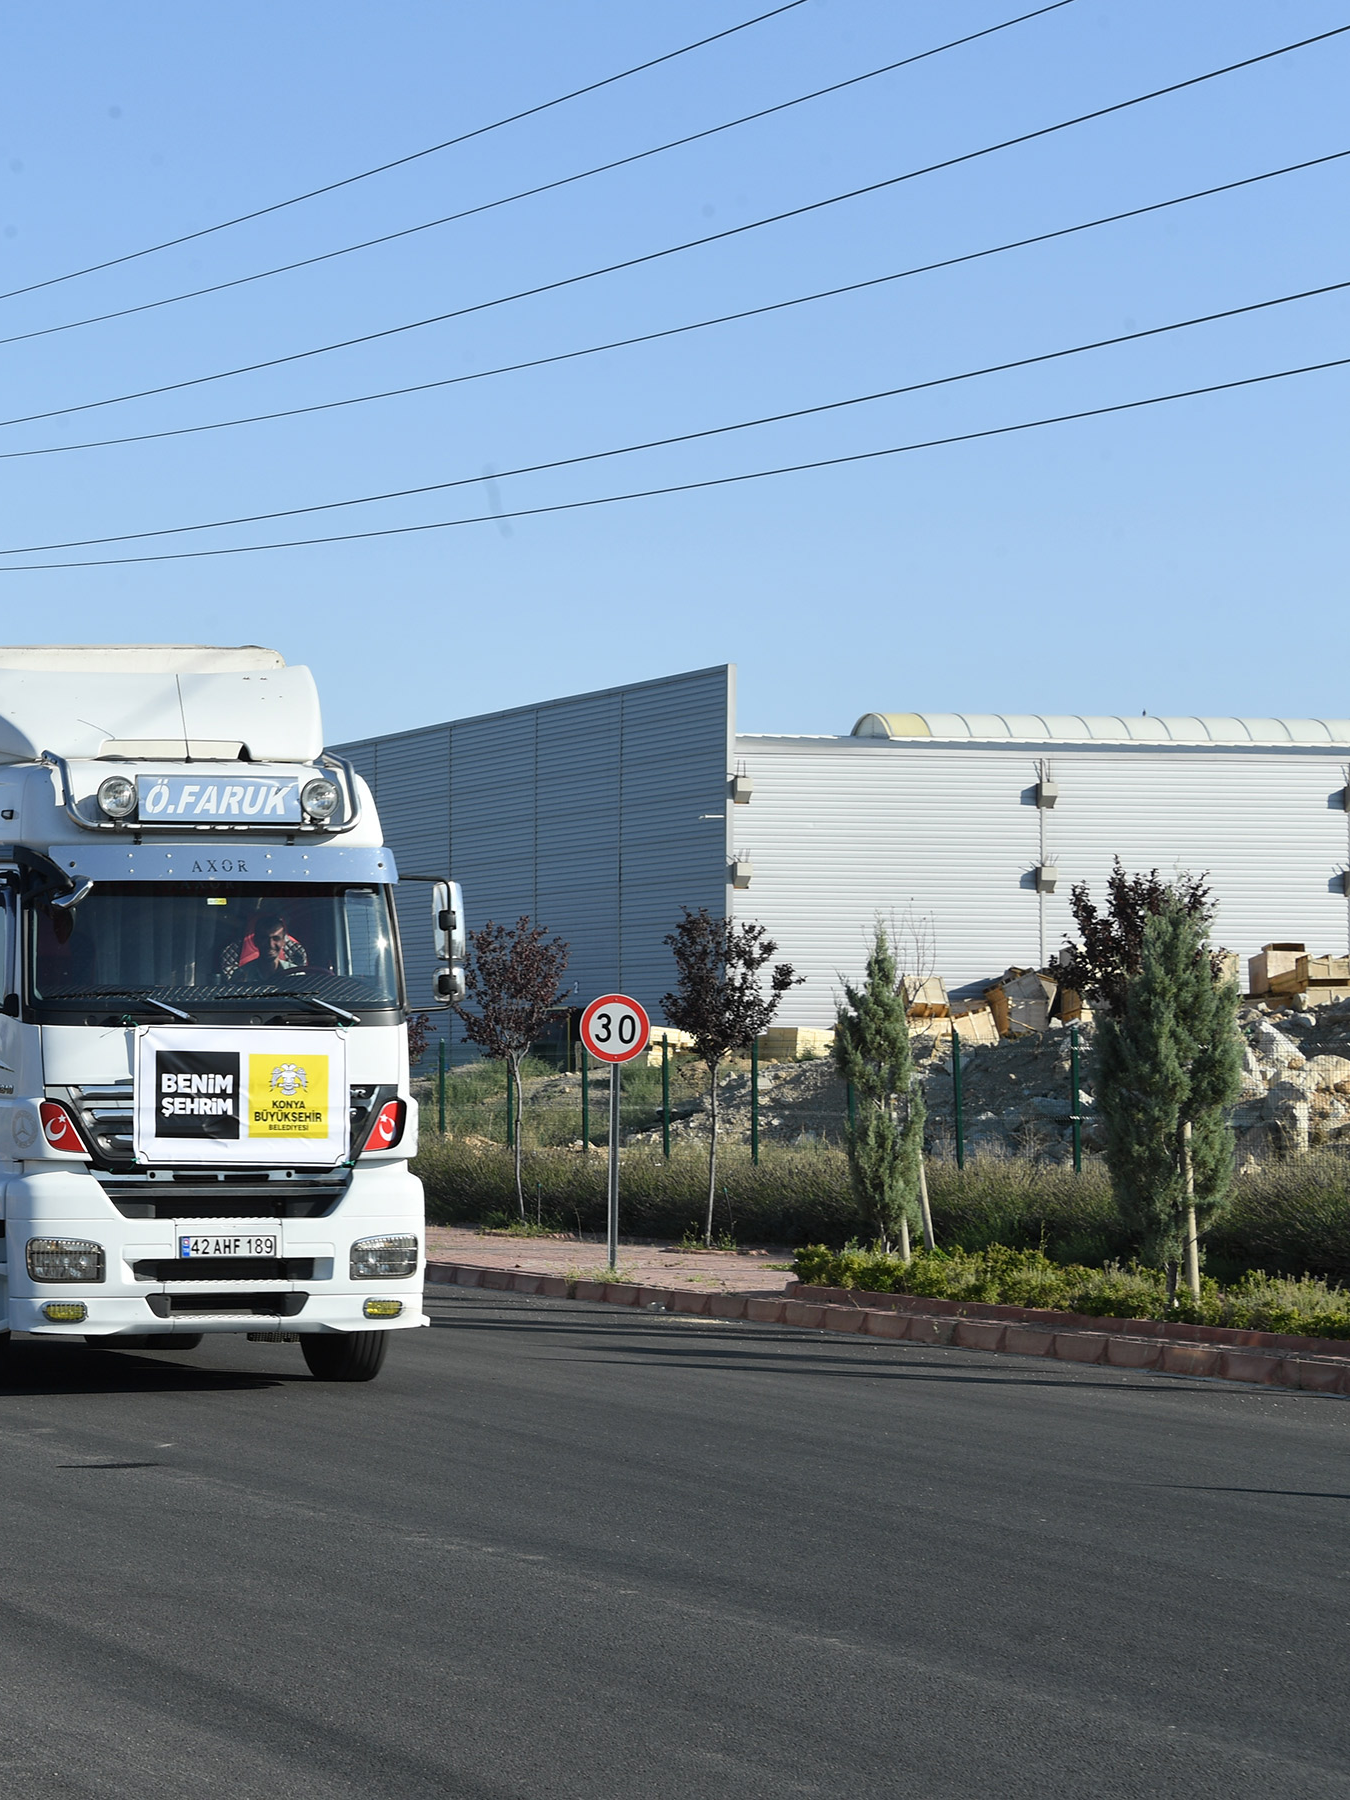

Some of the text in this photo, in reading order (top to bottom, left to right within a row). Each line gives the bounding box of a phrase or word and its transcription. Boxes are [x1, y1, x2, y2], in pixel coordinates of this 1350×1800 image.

[145, 779, 291, 815] Ö.FARUK
[191, 859, 248, 873] AXOR
[595, 1013, 636, 1044] 30
[272, 1100, 306, 1109] KONYA
[191, 1238, 273, 1254] 42 AHF 189
